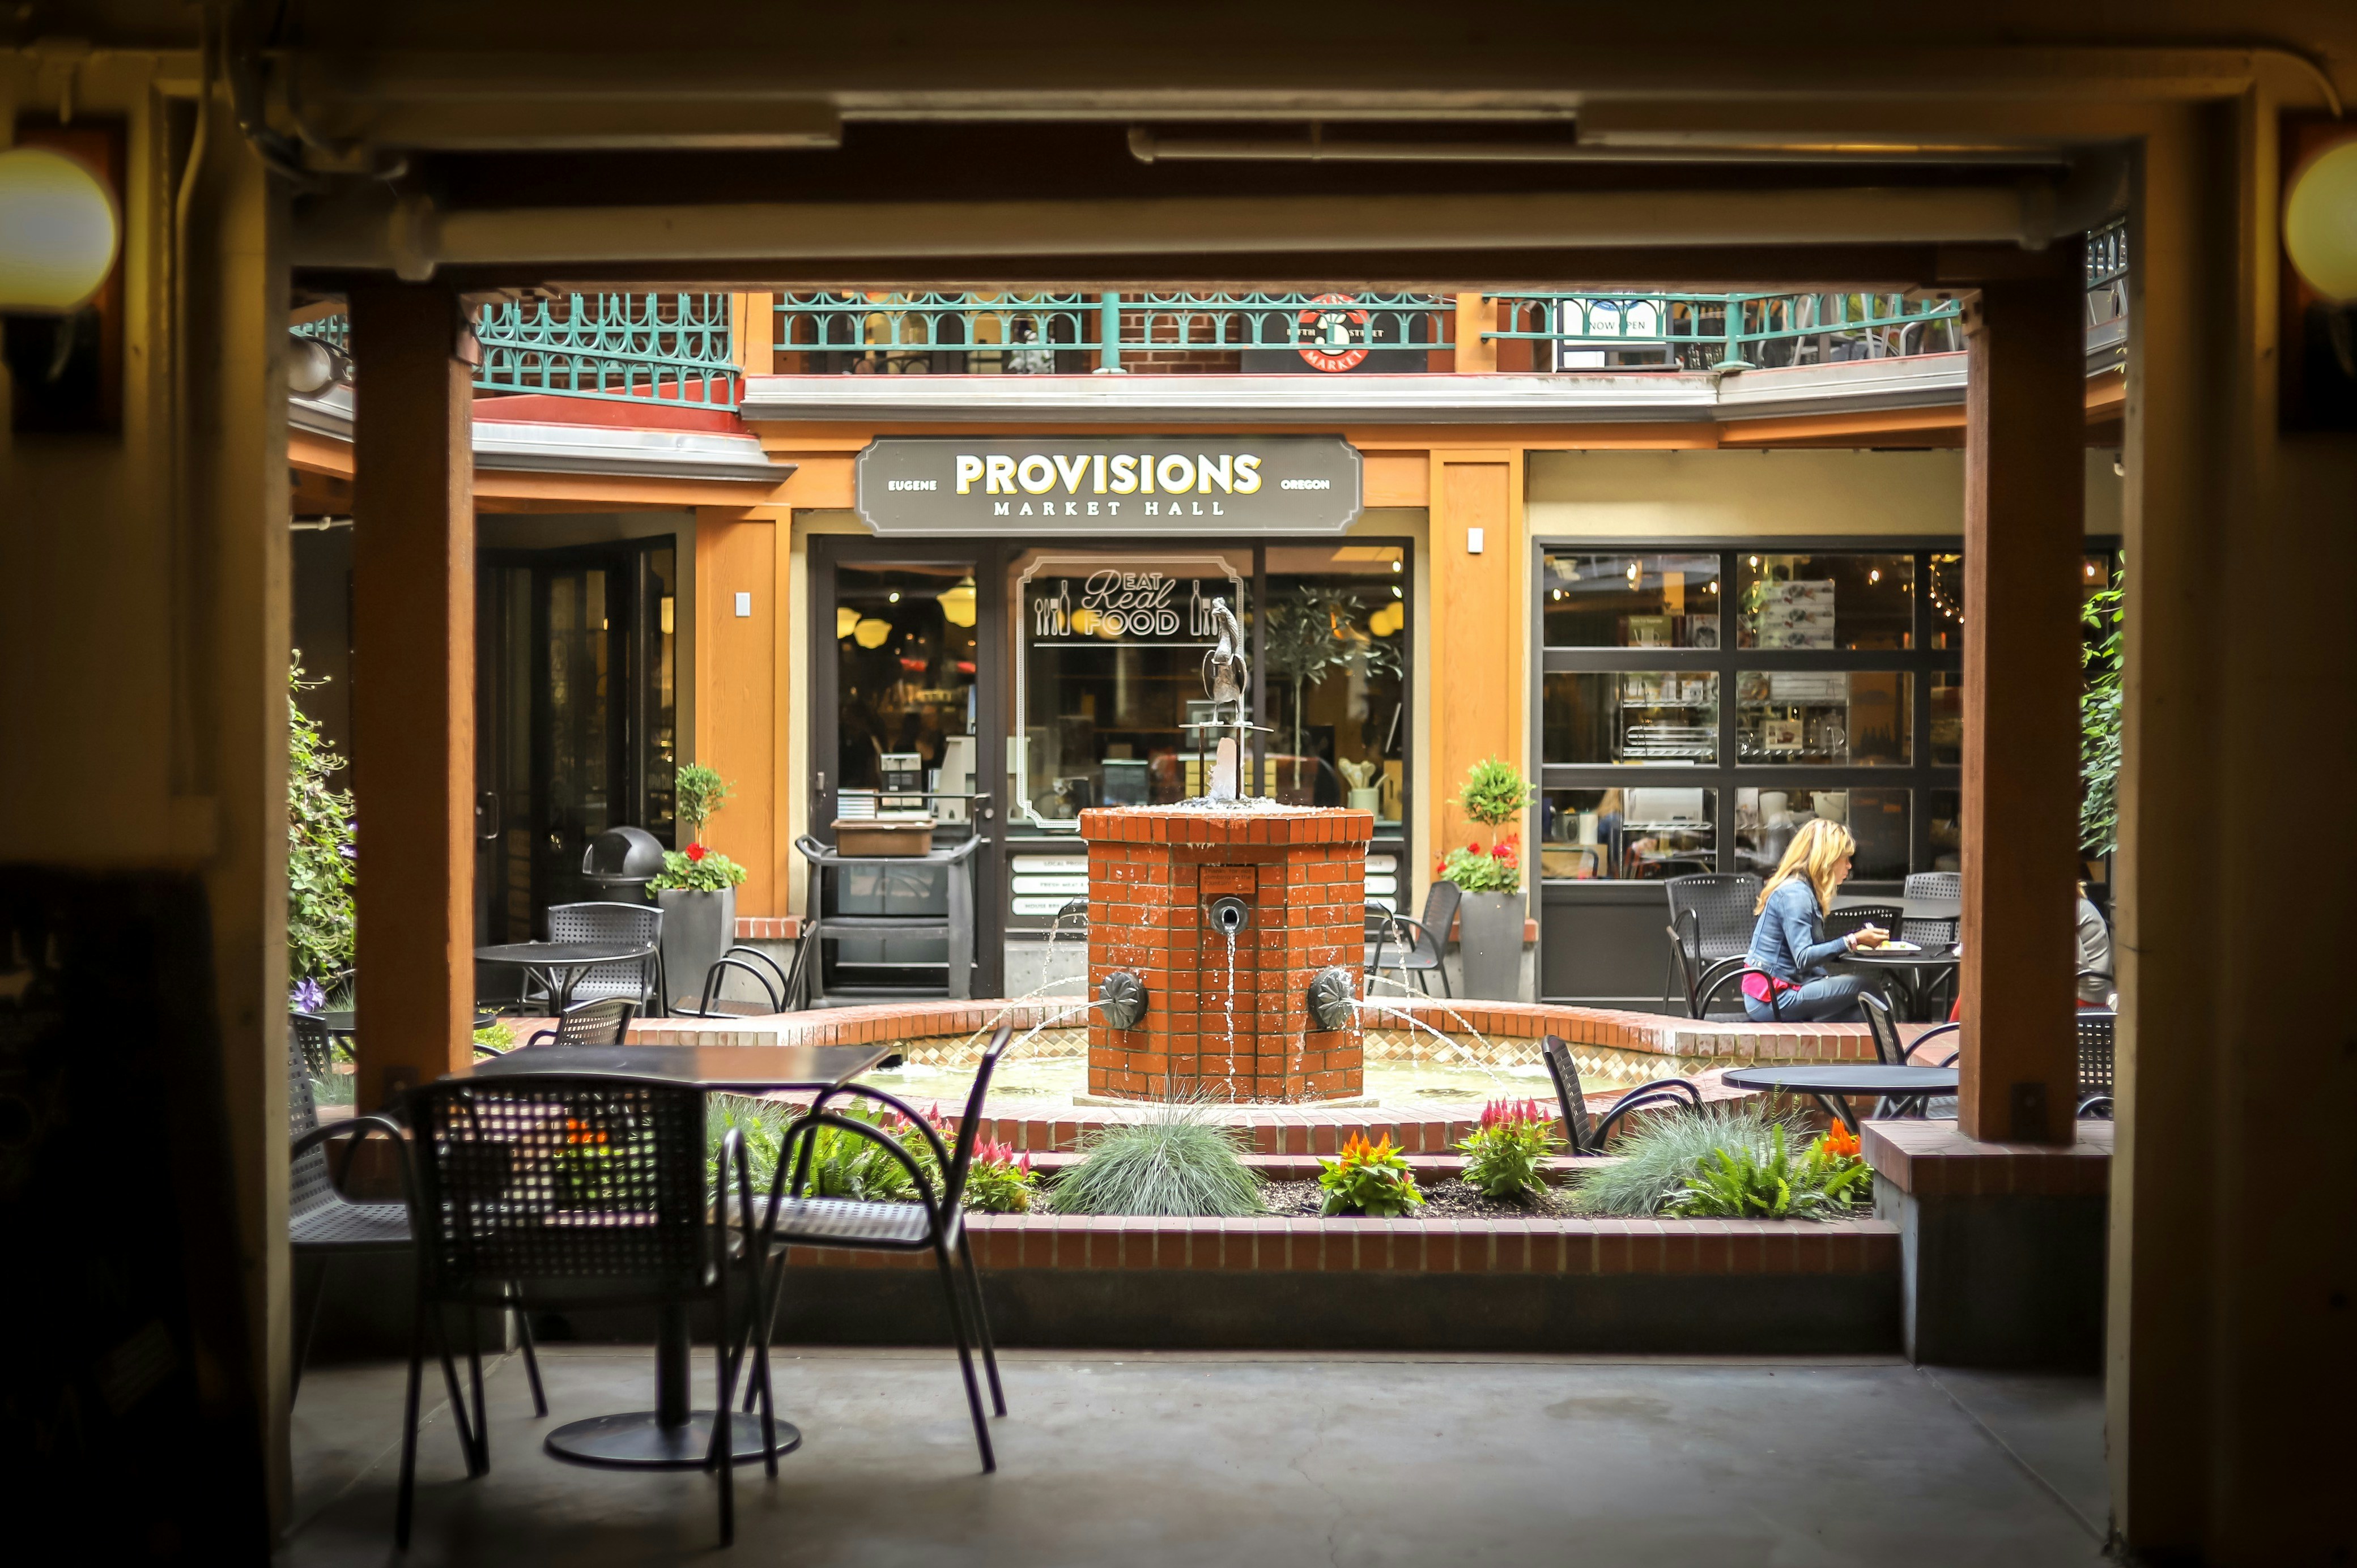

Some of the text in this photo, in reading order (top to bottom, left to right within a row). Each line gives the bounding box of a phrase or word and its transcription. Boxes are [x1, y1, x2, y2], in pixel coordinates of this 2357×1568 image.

[1305, 350, 1362, 370] MARKET
[955, 454, 1262, 495] PROVISIONS
[888, 480, 937, 491] EUGENE
[1280, 479, 1330, 490] OREGON
[993, 501, 1224, 515] MARKET HALL
[1080, 569, 1177, 610] Real
[1123, 572, 1163, 590] EAT
[1084, 609, 1180, 636] FOOD
